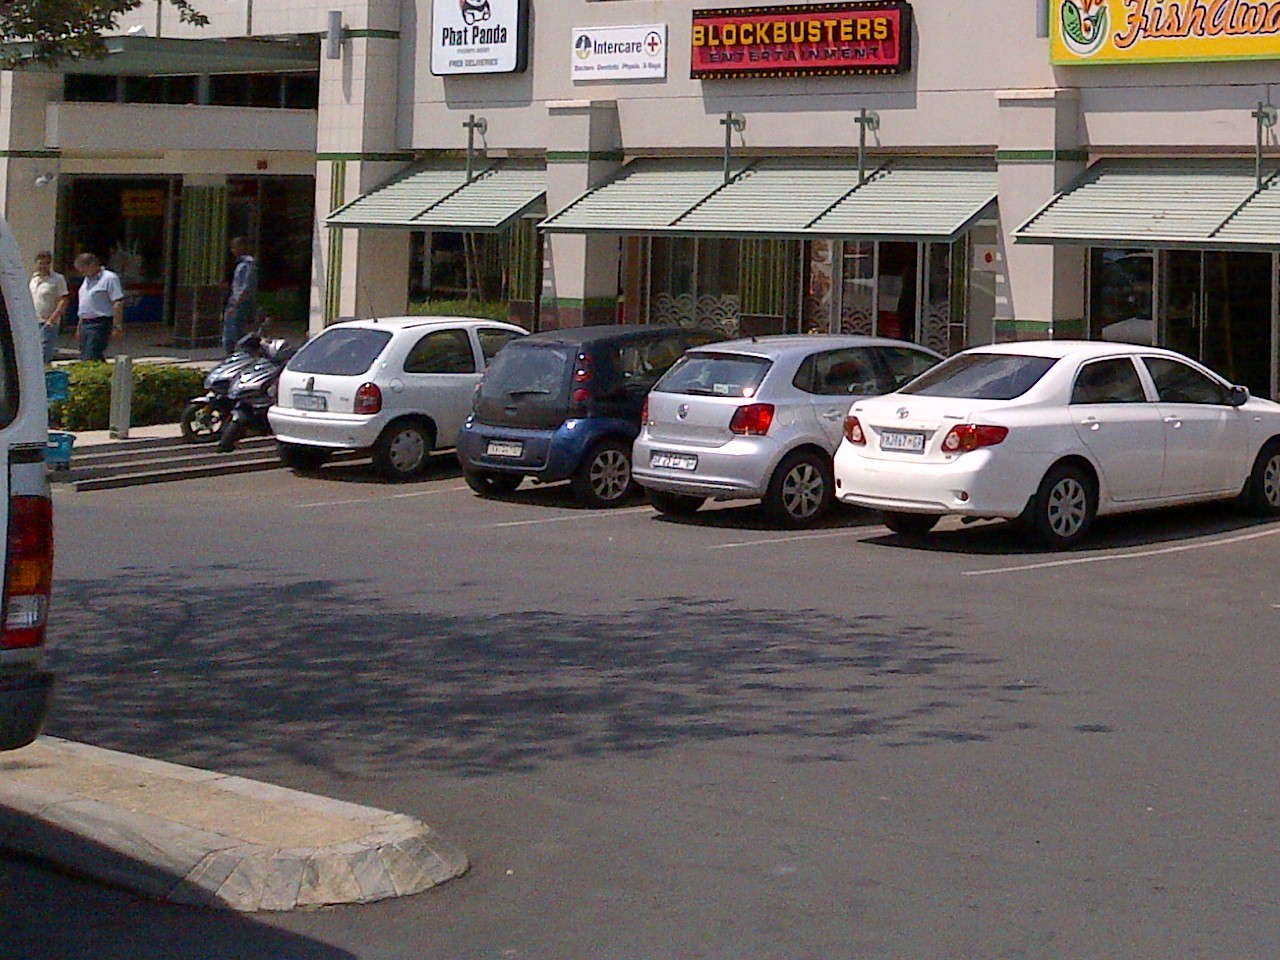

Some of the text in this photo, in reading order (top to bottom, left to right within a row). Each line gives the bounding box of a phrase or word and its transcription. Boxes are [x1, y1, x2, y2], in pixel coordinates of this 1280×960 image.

[442, 24, 508, 47] Phat Panda
[693, 17, 888, 46] BLOCKBUSTERS
[593, 40, 643, 55] Intercare
[709, 47, 880, 63] ENTERTAINMENT
